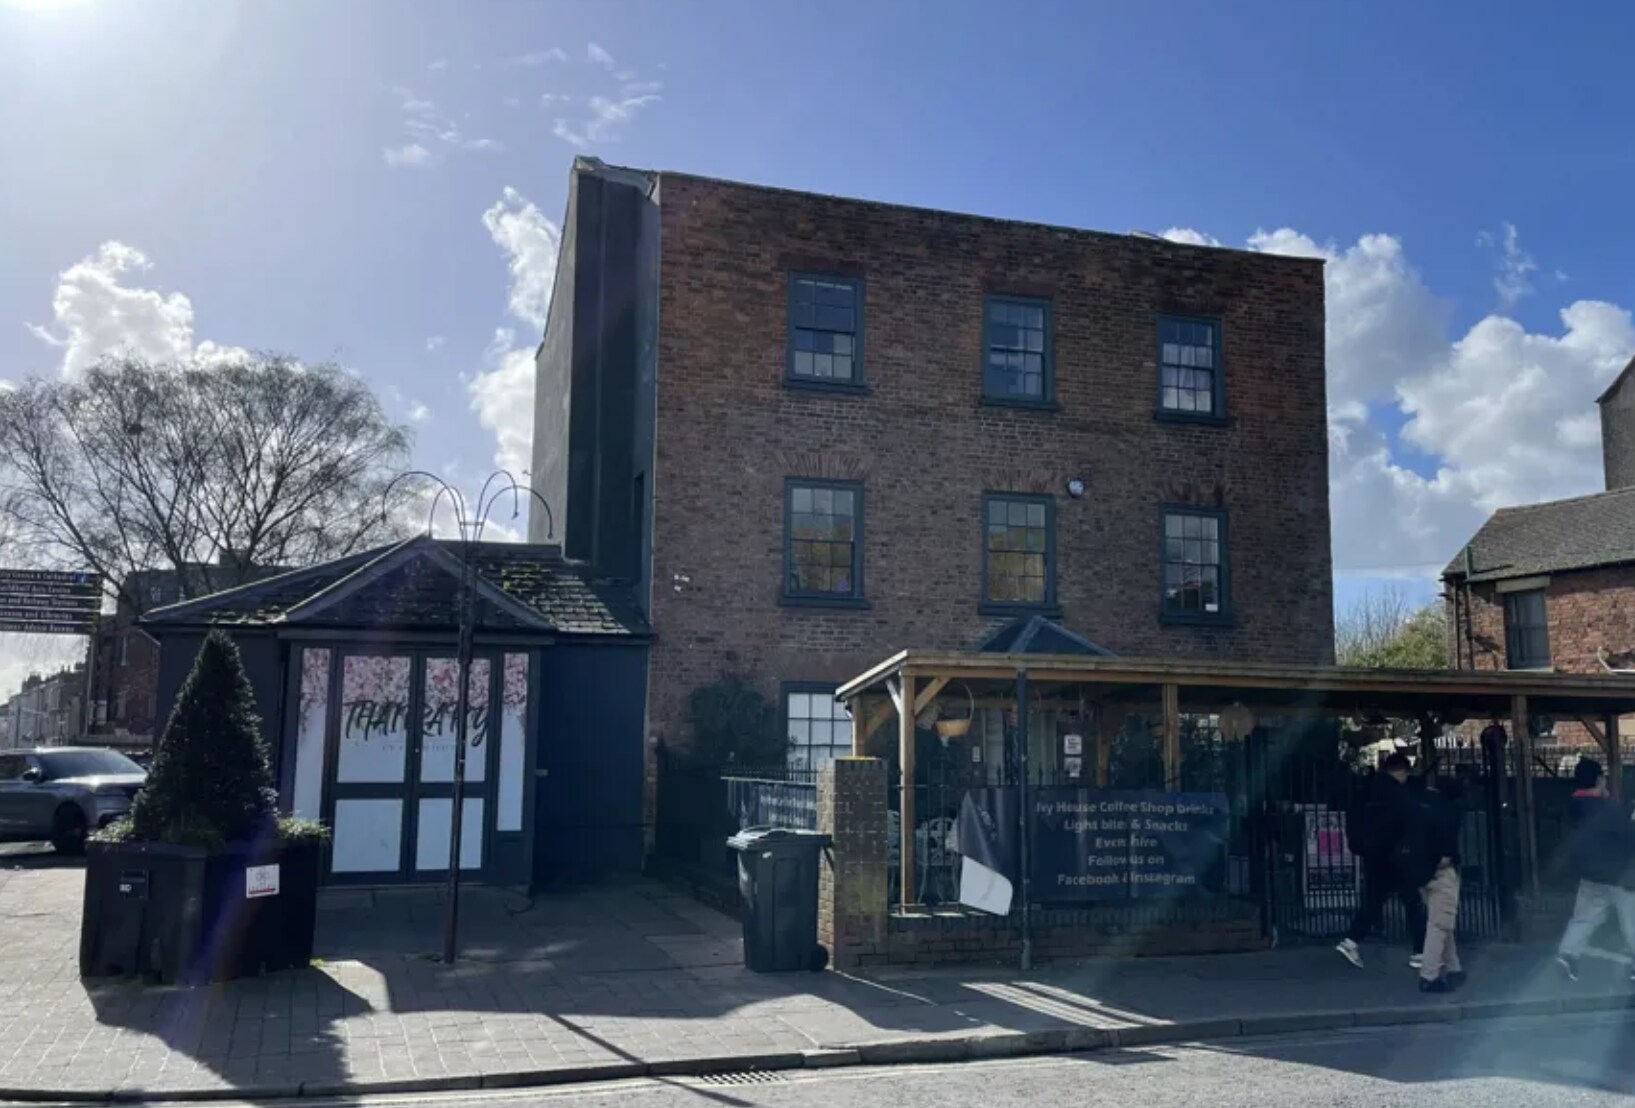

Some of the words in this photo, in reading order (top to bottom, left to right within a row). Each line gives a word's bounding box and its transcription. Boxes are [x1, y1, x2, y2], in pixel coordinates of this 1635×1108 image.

[1036, 801, 1053, 815] Ivy
[1056, 801, 1096, 813] House
[1100, 801, 1138, 813] Coffee
[1140, 802, 1174, 816] Shop
[1064, 819, 1098, 834] Light
[1130, 819, 1141, 830] &
[1144, 819, 1188, 832] Snacks
[1095, 837, 1127, 849] Even
[1148, 856, 1165, 866] on
[1057, 873, 1119, 885] Facebook
[1130, 871, 1196, 886] Instagram
